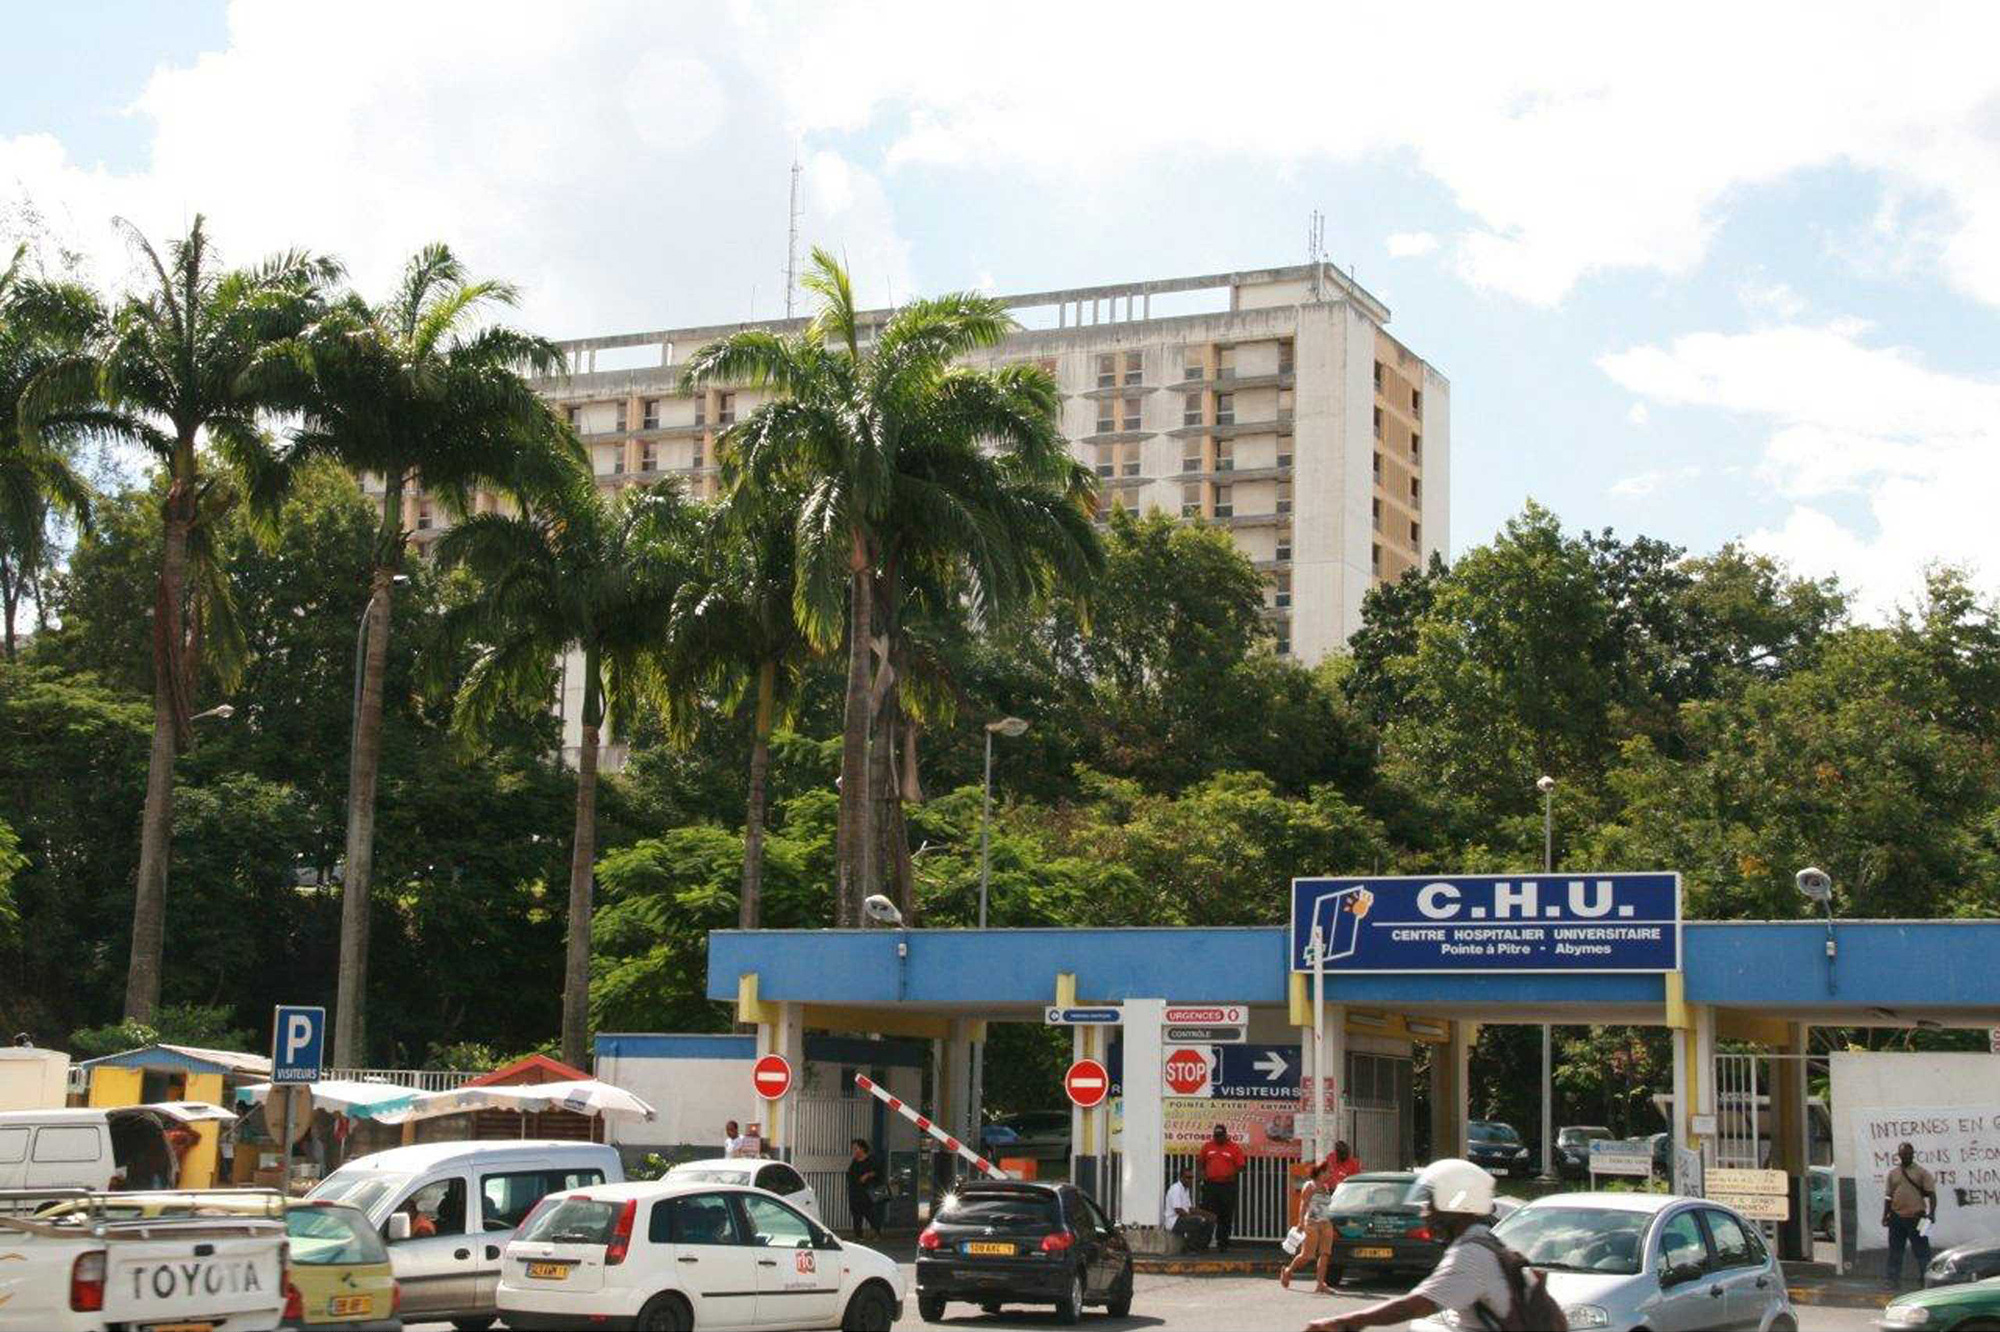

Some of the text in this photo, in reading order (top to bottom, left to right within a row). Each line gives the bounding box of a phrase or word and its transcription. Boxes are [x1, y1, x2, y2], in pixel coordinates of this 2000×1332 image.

[1416, 880, 1635, 919] C.H.U.
[1392, 927, 1661, 941] CENTRE HOSPITALIER UNIVERSITAIRE
[1441, 943, 1484, 955] Pointe
[1486, 943, 1495, 954] à
[1498, 943, 1531, 954] Pitre
[1555, 943, 1612, 956] Abymes
[1169, 1011, 1222, 1021] URGENCES
[286, 1014, 312, 1064] P
[277, 1067, 317, 1079] VISITEURS
[1166, 1062, 1206, 1081] STOP
[1221, 1086, 1301, 1097] VISITEURS
[1870, 1119, 1950, 1139] INTERNES
[1959, 1117, 1983, 1133] EN
[127, 1261, 262, 1299] TOYOTA
